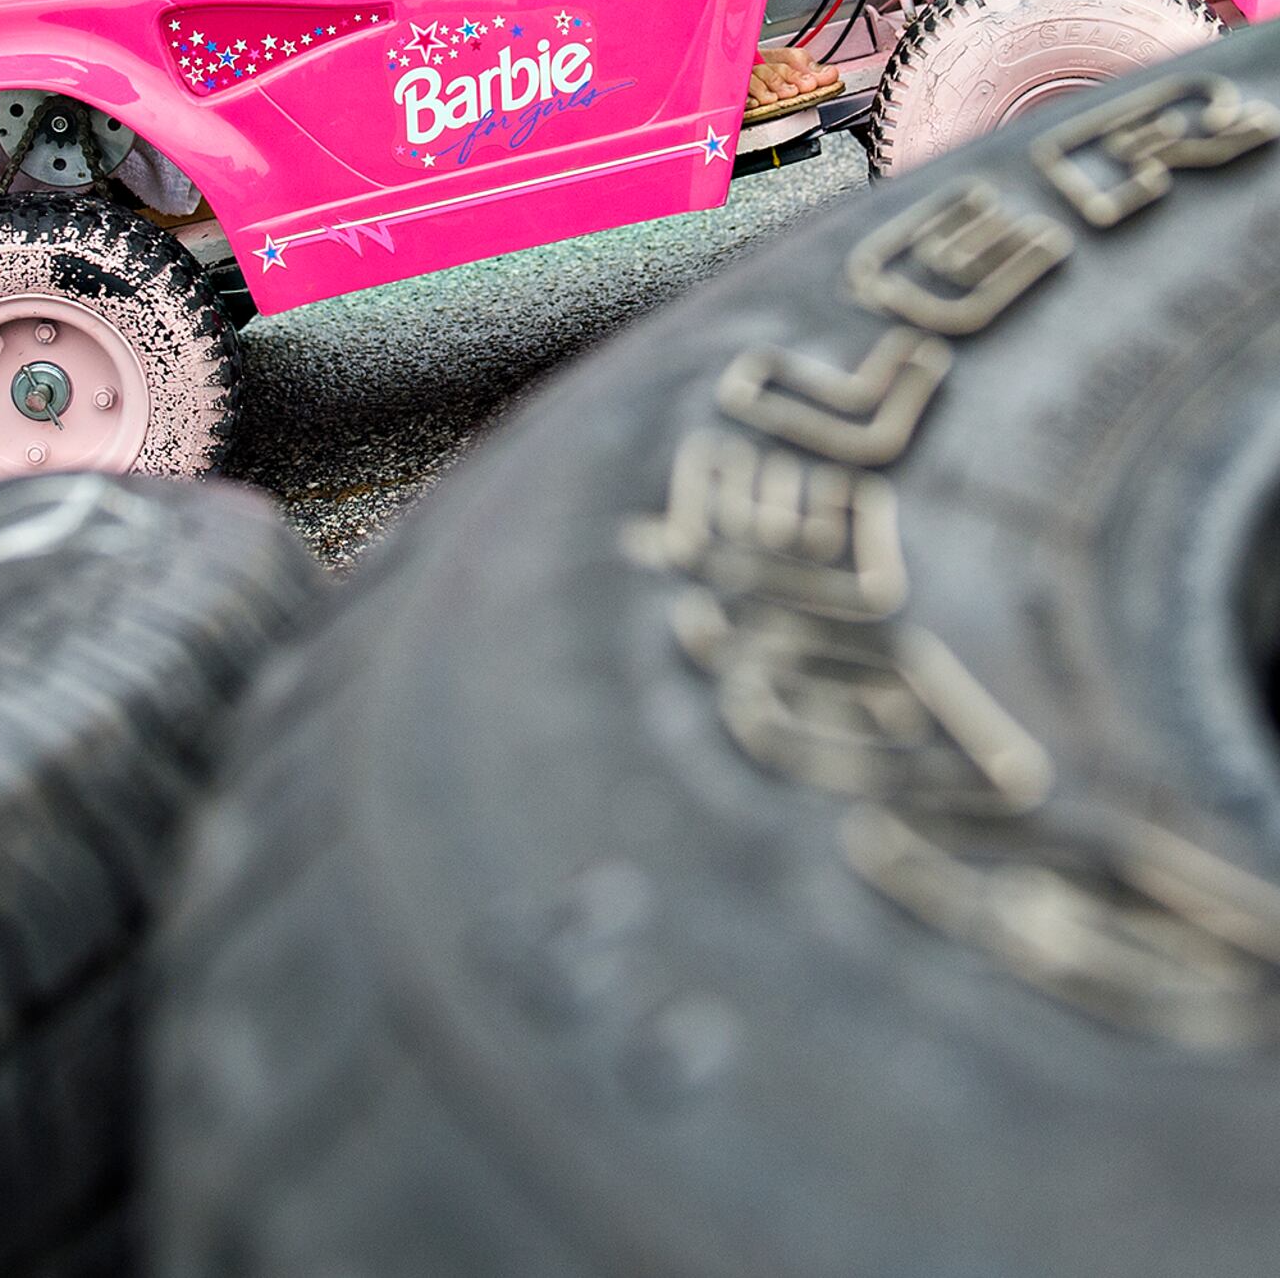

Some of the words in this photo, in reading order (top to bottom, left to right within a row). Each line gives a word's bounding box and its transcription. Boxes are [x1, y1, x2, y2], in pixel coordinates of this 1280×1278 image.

[1038, 22, 1157, 62] SEARS
[393, 38, 594, 145] Barbie
[435, 108, 514, 165] for
[509, 80, 637, 149] girls
